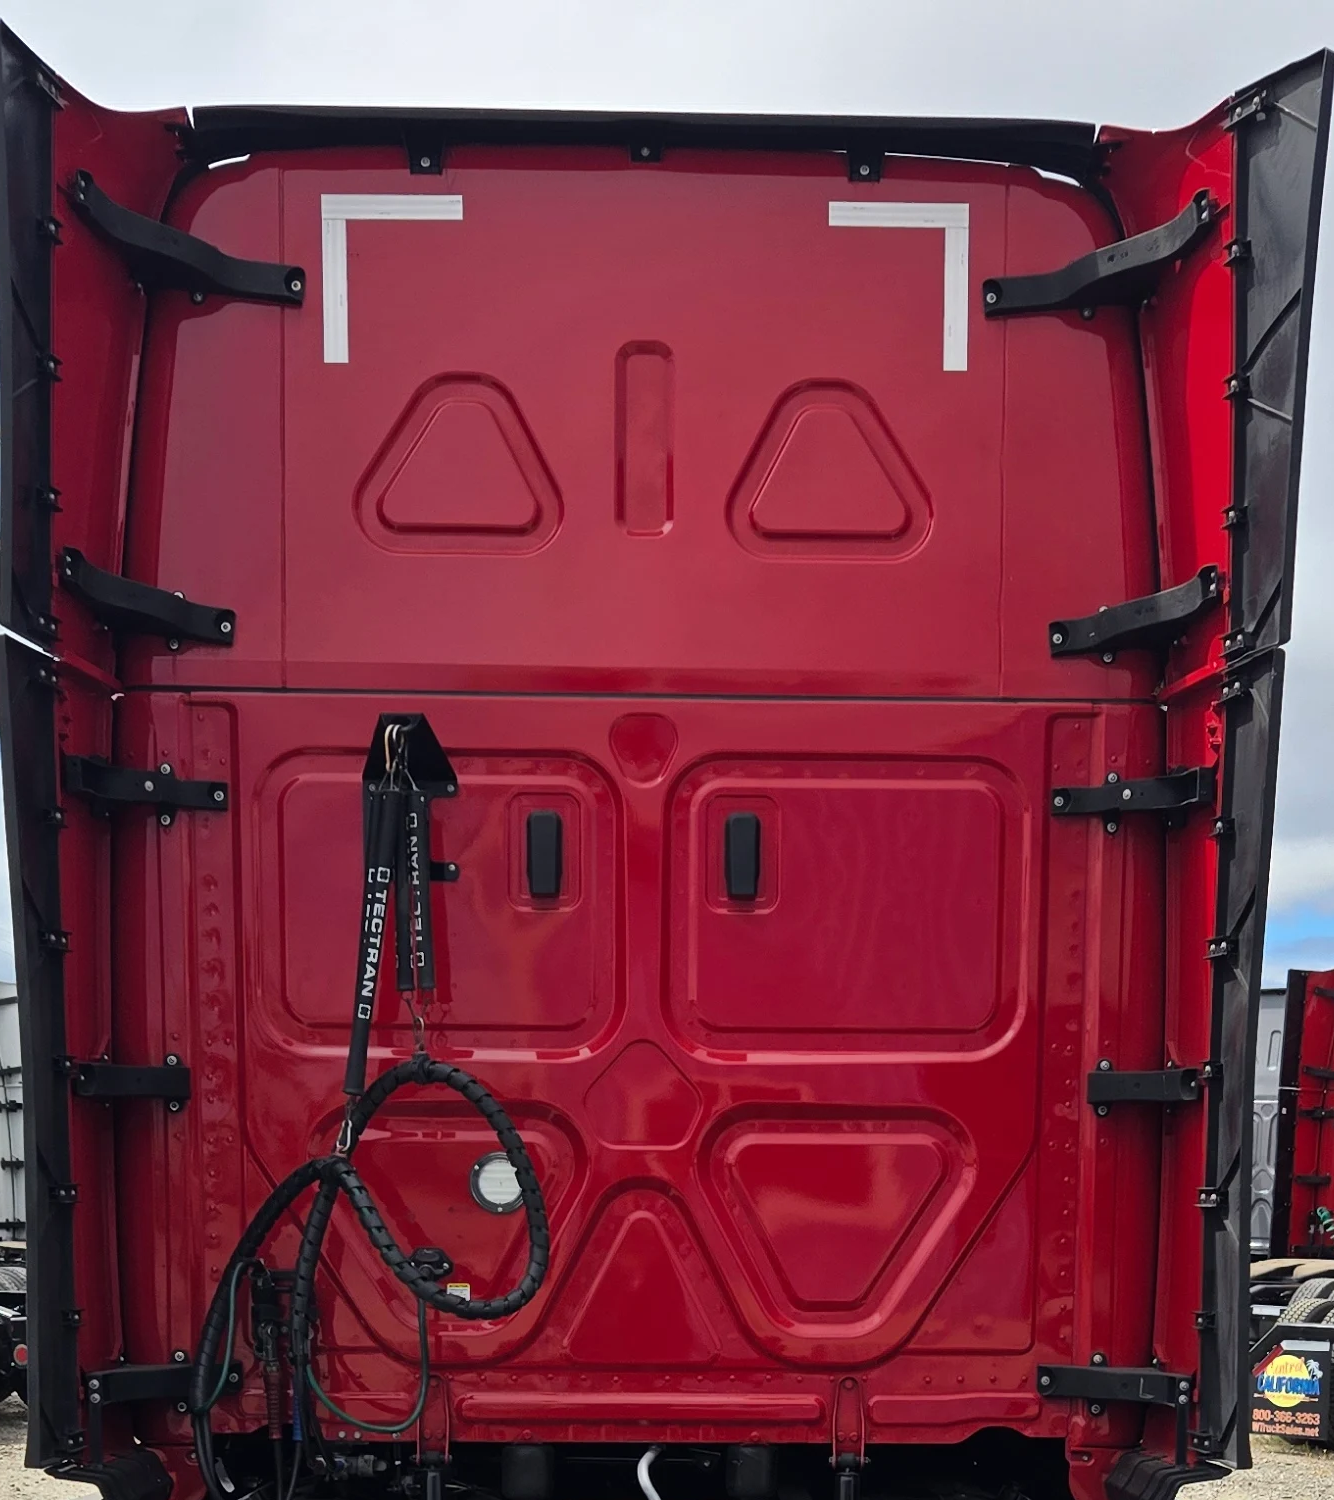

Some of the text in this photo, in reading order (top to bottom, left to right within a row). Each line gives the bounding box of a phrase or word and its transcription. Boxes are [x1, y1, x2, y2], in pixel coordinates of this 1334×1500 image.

[361, 889, 388, 998] TECTRAN
[1257, 1373, 1320, 1395] CALIFORNIA
[1252, 1408, 1320, 1425] 800-366-3263
